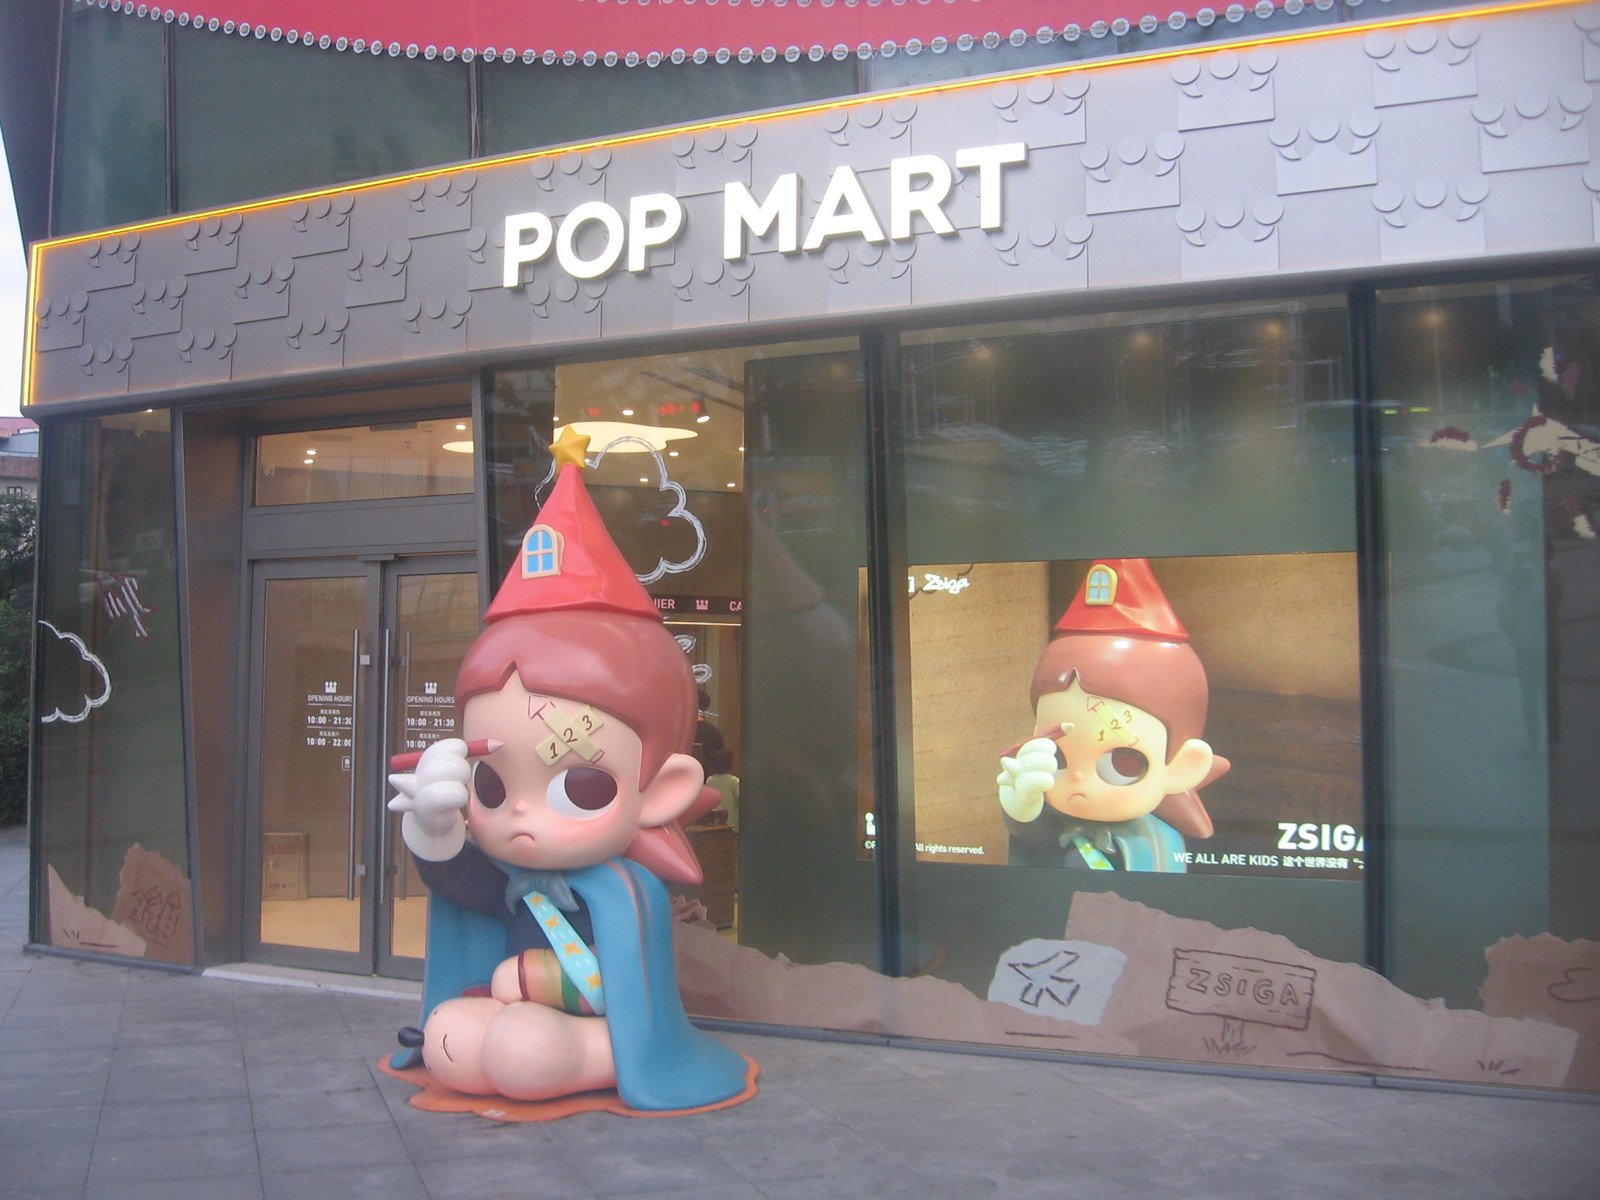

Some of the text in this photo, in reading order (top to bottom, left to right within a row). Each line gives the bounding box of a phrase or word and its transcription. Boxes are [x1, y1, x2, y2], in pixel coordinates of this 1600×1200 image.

[503, 142, 1029, 289] POP MART
[307, 694, 352, 703] OPENING HOURS
[406, 696, 455, 704] OPENING HOURS
[307, 716, 326, 724] 10:00
[407, 718, 427, 726] 10:00
[434, 719, 455, 727] 21:30
[306, 737, 326, 746] 10:00
[406, 740, 426, 748] 10:00
[925, 844, 947, 855] rights
[948, 845, 985, 855] reserved.
[1173, 852, 1193, 864] WE
[1195, 853, 1219, 865] ALL
[1221, 853, 1247, 866] ARE
[1249, 854, 1279, 867] KIDS
[1186, 967, 1299, 1006] ZSIGA
